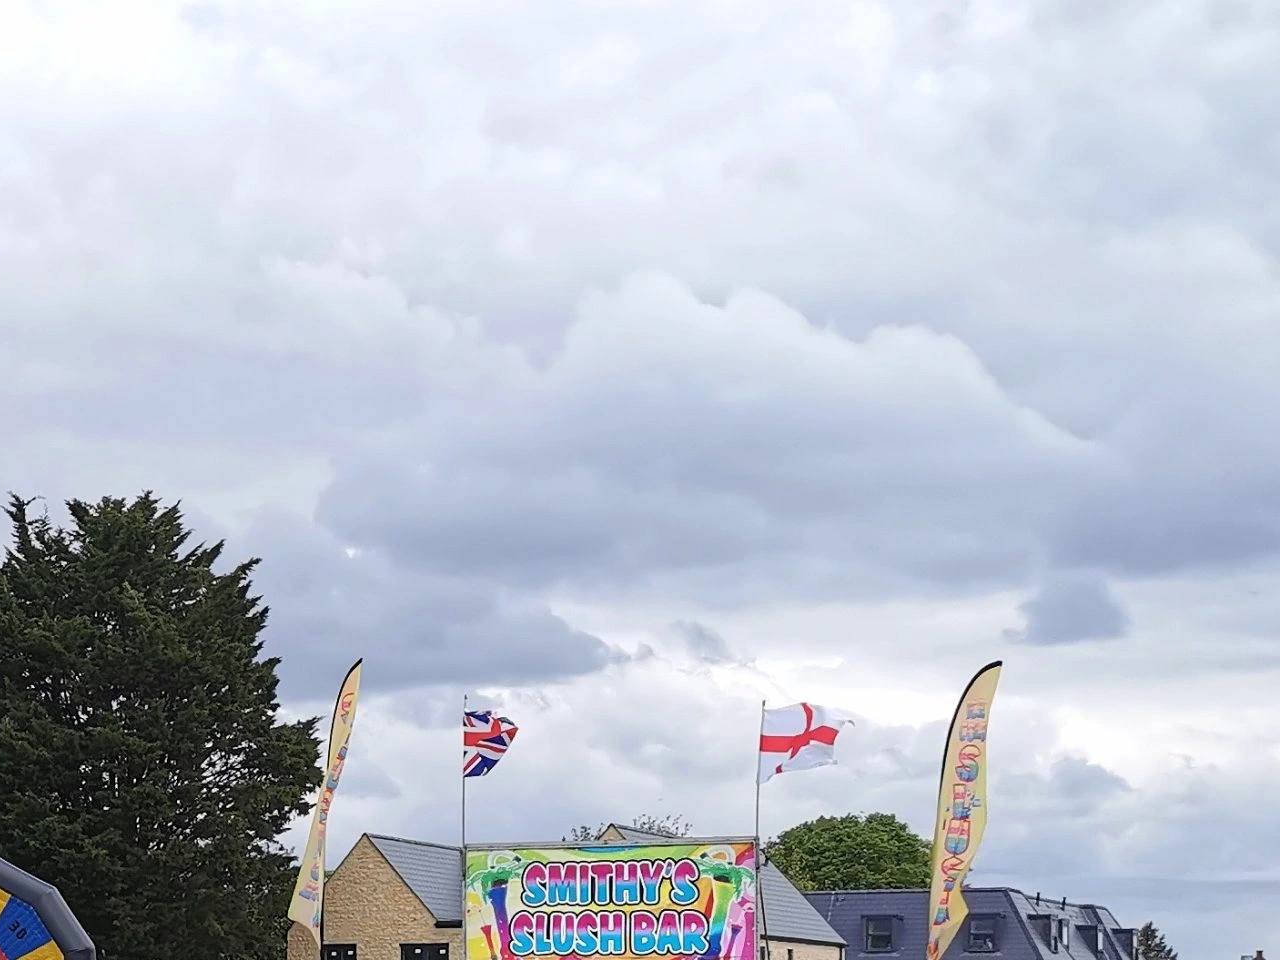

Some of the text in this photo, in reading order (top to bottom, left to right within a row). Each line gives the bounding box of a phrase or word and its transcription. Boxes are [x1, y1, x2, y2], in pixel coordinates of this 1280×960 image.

[521, 858, 699, 906] SMITHY'S
[9, 920, 27, 940] 30
[510, 910, 710, 956] SLUSH BAR
